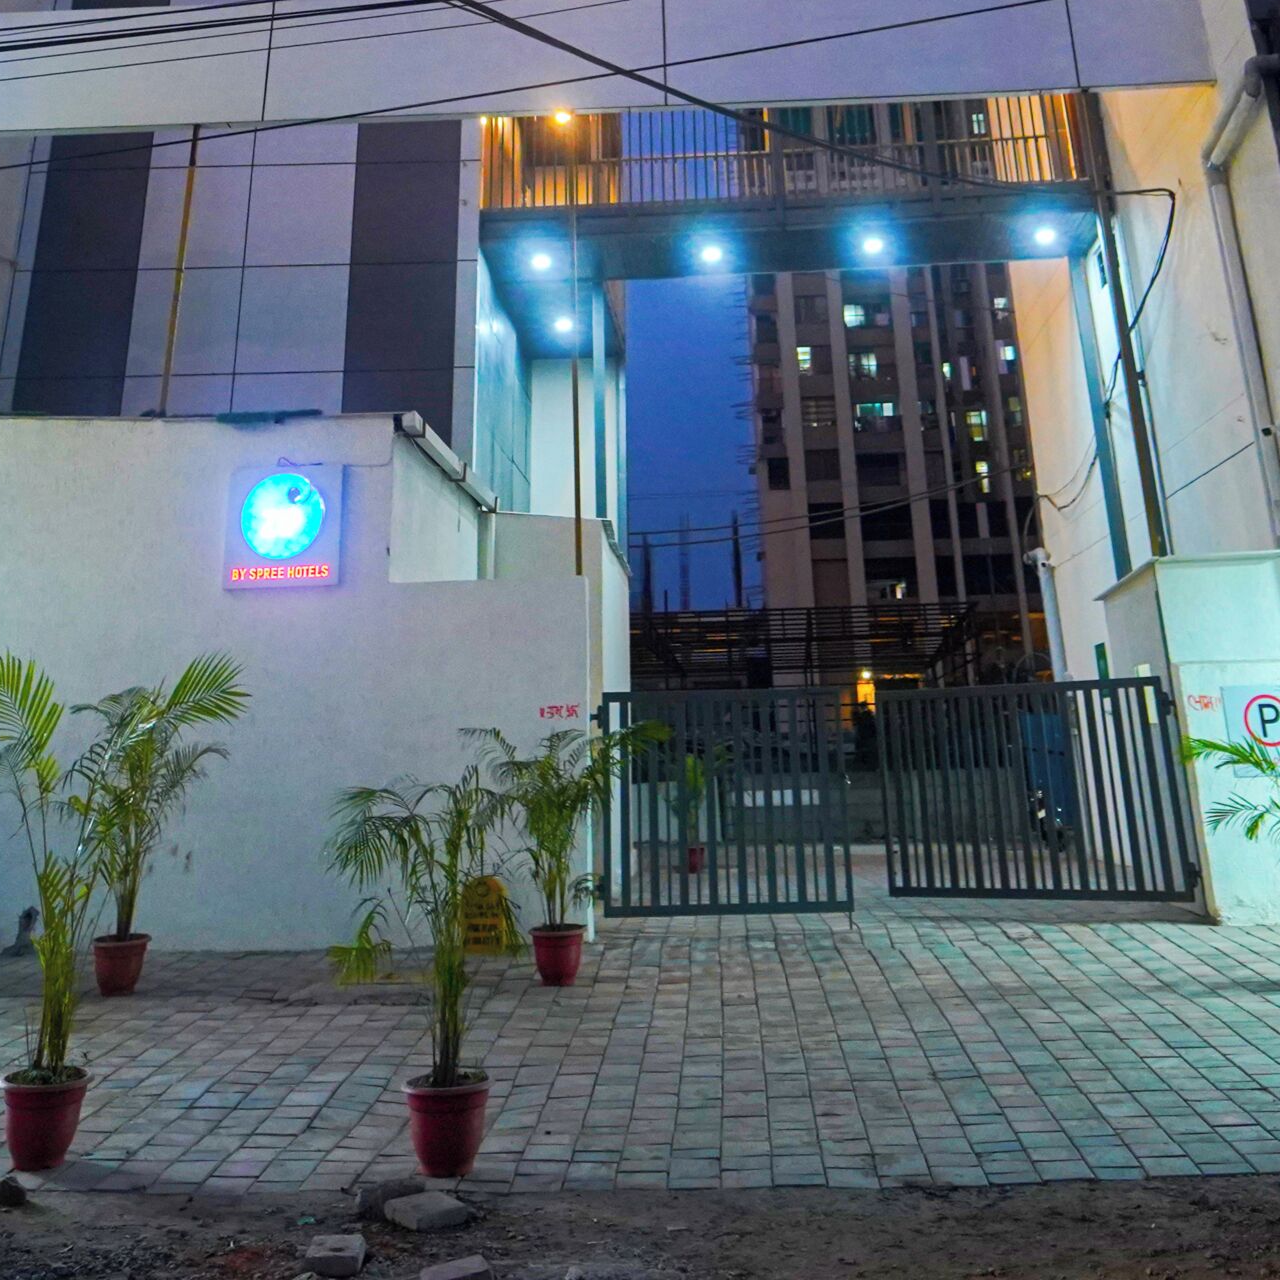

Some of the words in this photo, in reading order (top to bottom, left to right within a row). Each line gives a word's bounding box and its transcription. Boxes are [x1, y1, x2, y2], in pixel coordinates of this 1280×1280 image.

[232, 568, 247, 581] BY
[249, 566, 285, 580] SPREE
[287, 565, 329, 579] HOTELS
[1258, 703, 1280, 738] P
